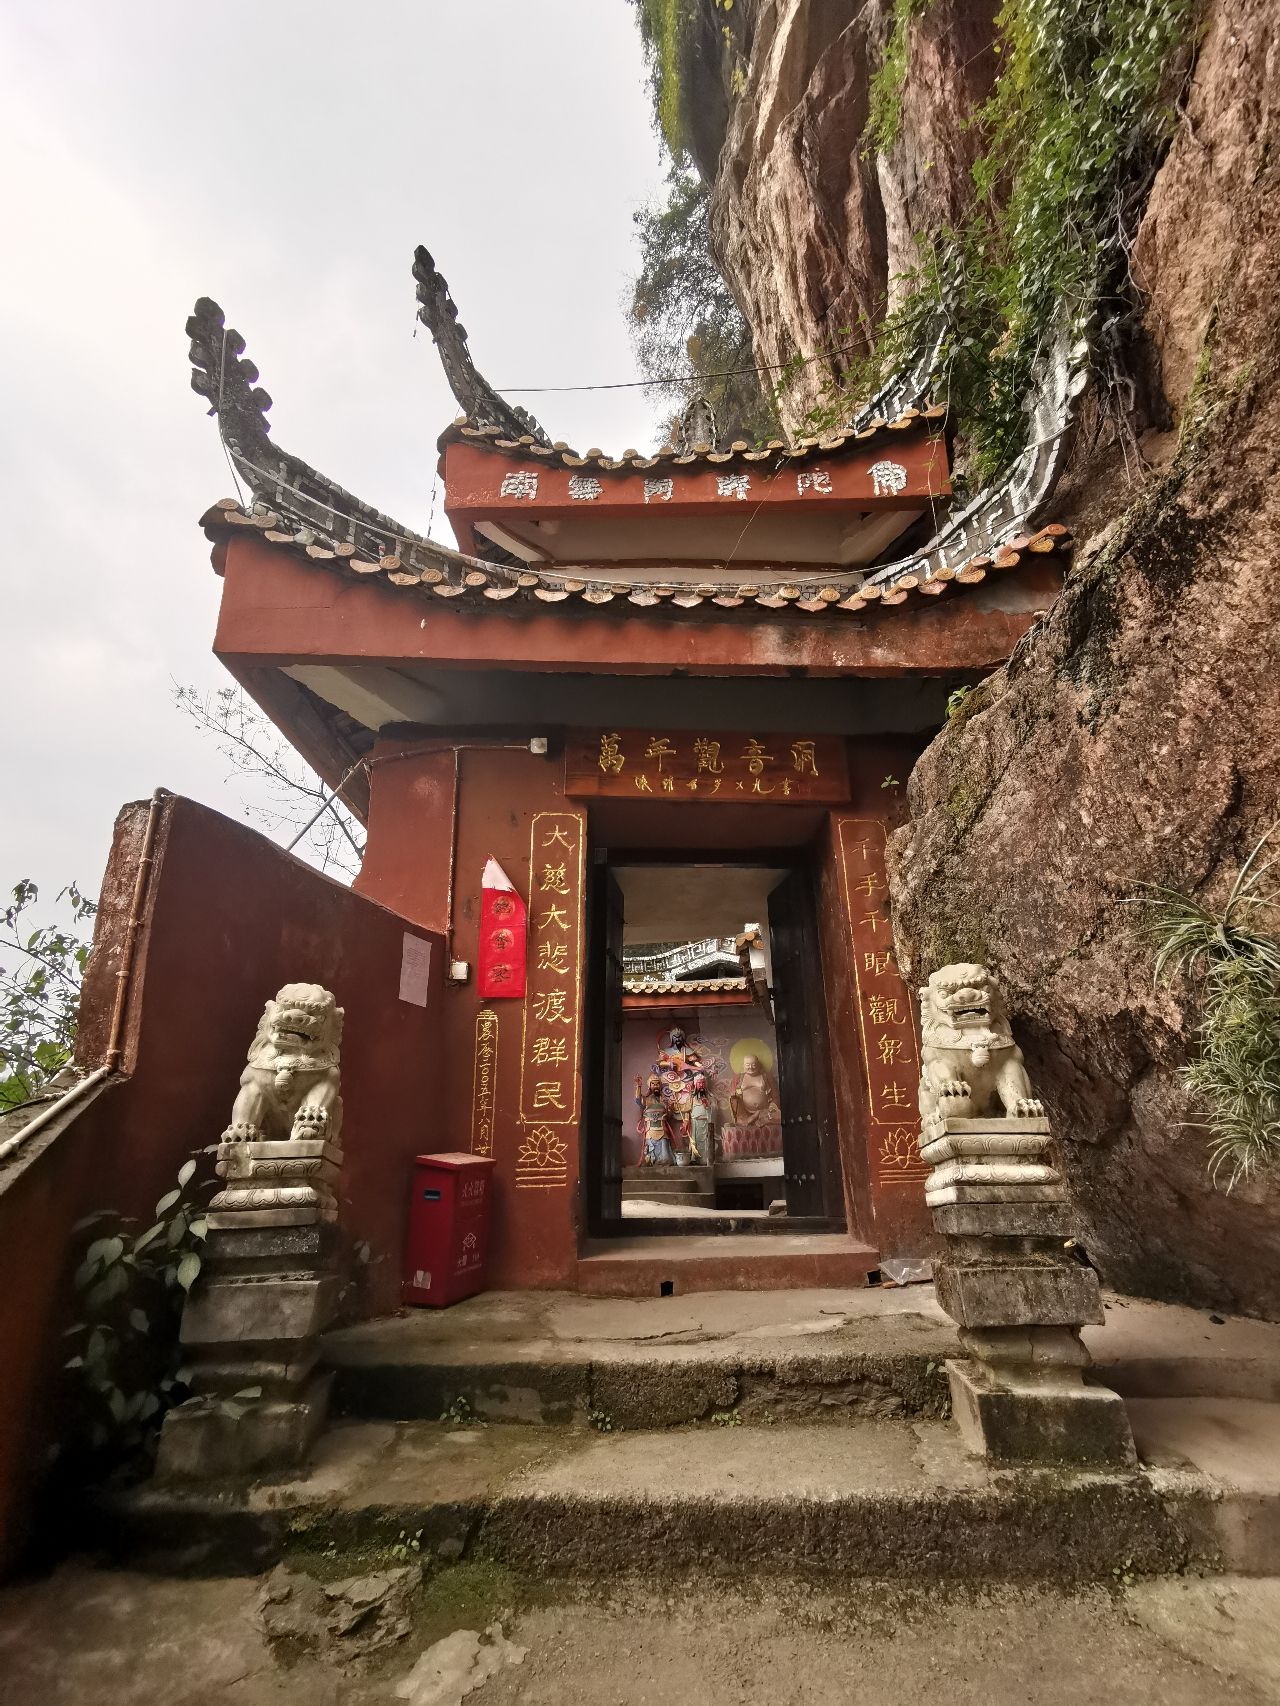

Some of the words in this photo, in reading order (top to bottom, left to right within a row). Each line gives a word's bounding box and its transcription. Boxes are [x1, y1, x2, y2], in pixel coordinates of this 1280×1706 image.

[531, 825, 575, 1110] 大慈大悲渡群民
